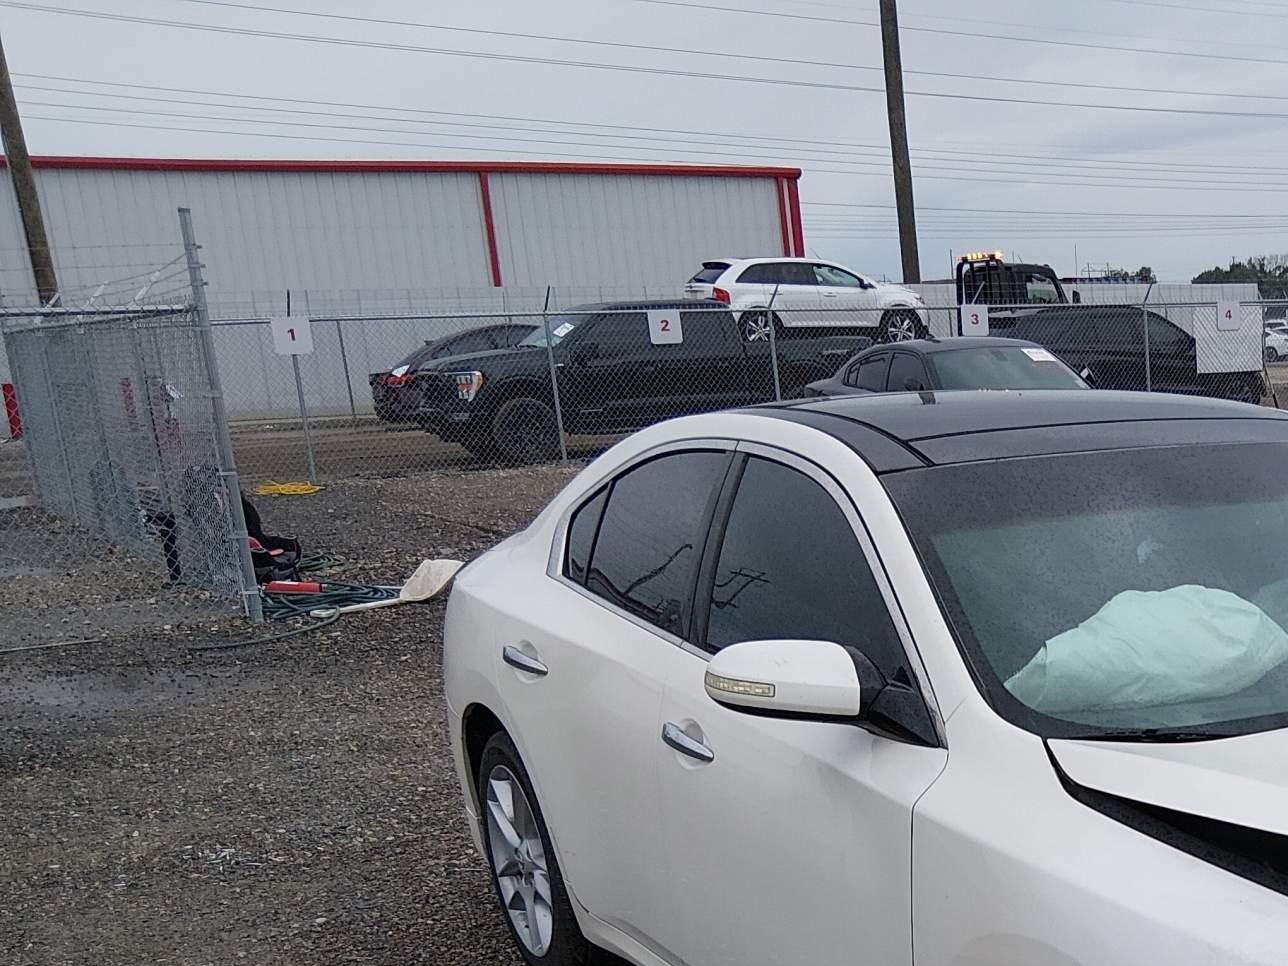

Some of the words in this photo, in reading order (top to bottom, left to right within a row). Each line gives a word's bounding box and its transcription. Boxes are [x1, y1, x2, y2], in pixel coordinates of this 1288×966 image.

[970, 313, 980, 326] 3
[1225, 309, 1232, 320] 4
[660, 319, 671, 332] 2
[287, 328, 295, 341] 1
